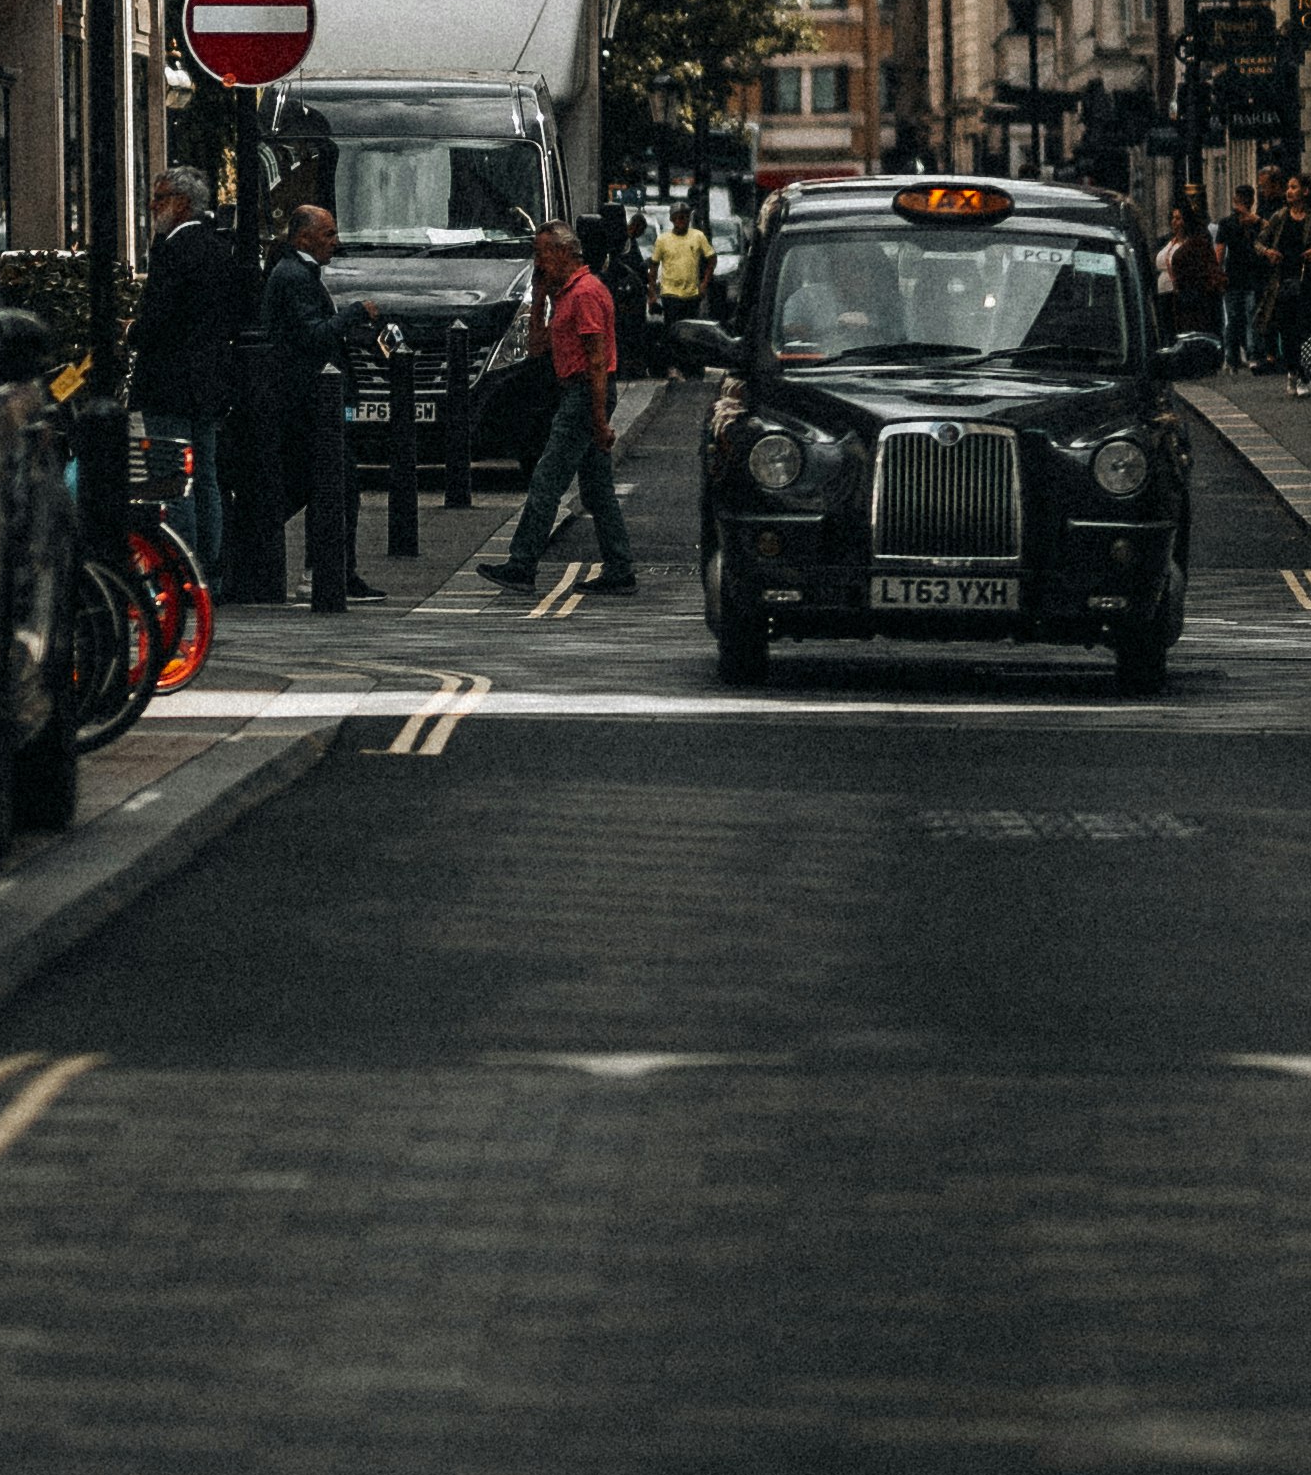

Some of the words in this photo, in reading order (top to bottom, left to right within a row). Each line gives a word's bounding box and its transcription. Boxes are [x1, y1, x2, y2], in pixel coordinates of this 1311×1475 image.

[355, 403, 390, 419] FP6
[880, 579, 951, 604] LT63
[957, 580, 1008, 605] YXH
